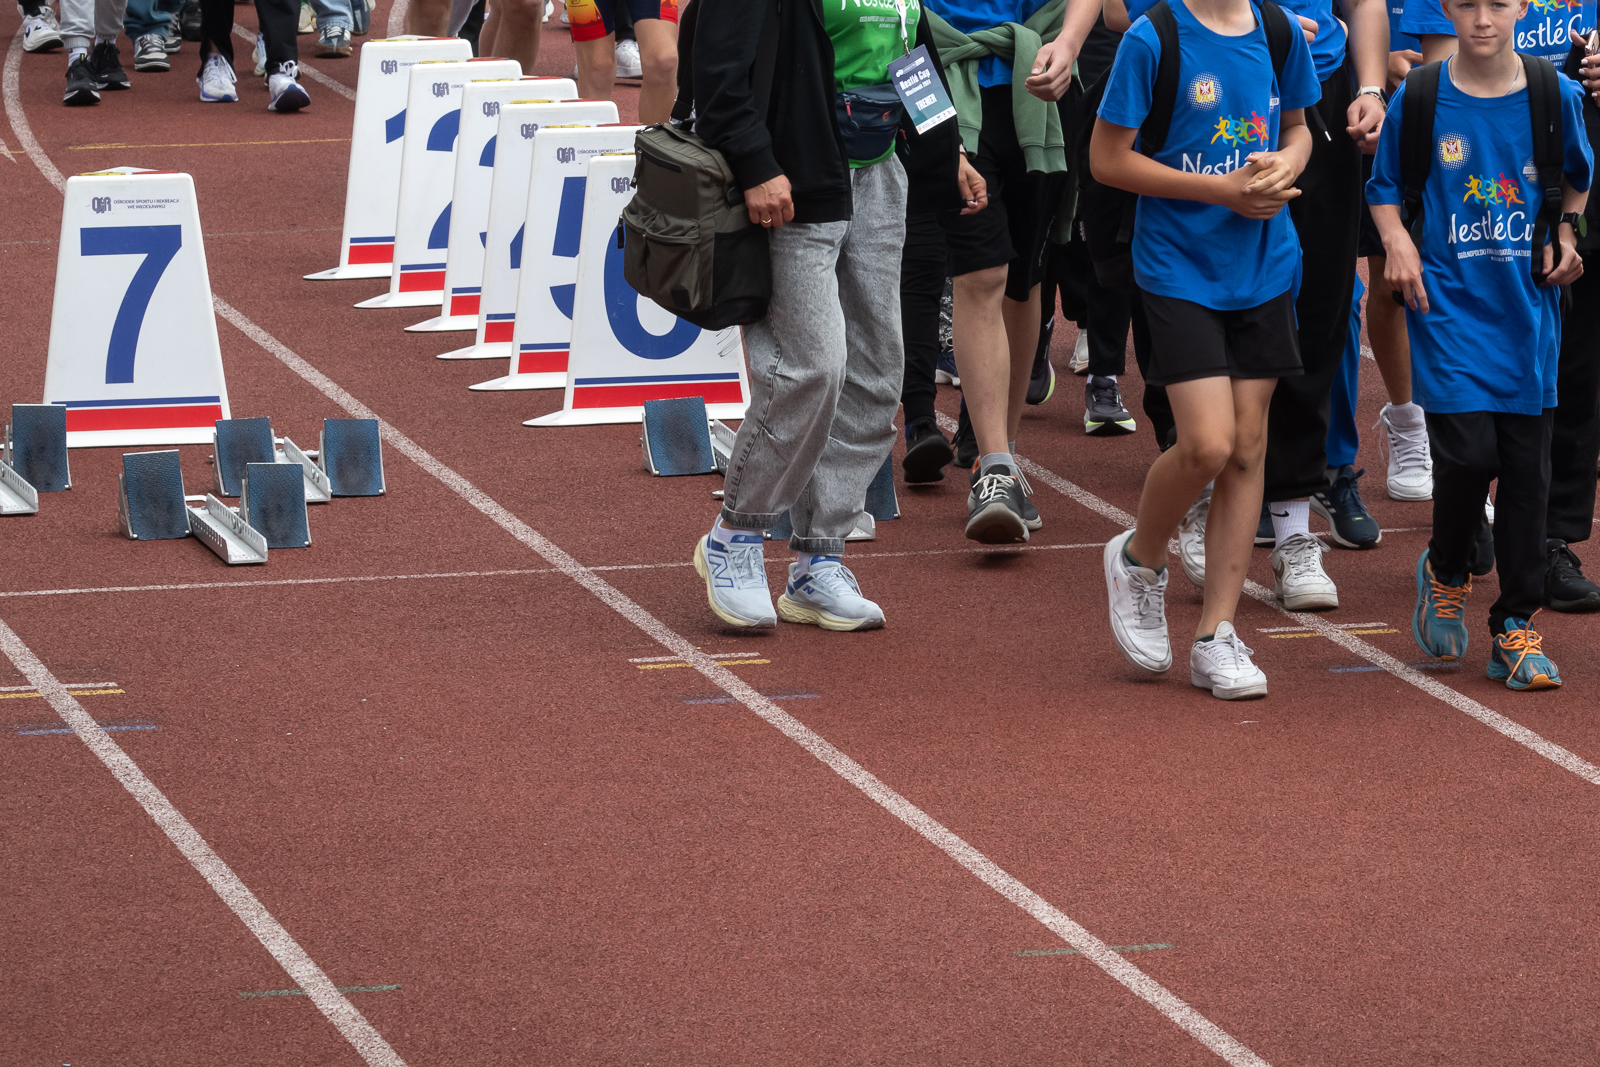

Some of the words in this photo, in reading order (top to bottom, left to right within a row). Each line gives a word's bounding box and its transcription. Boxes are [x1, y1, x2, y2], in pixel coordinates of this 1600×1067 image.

[917, 68, 931, 80] Cup
[915, 93, 938, 111] TRENER
[80, 224, 183, 385] 7
